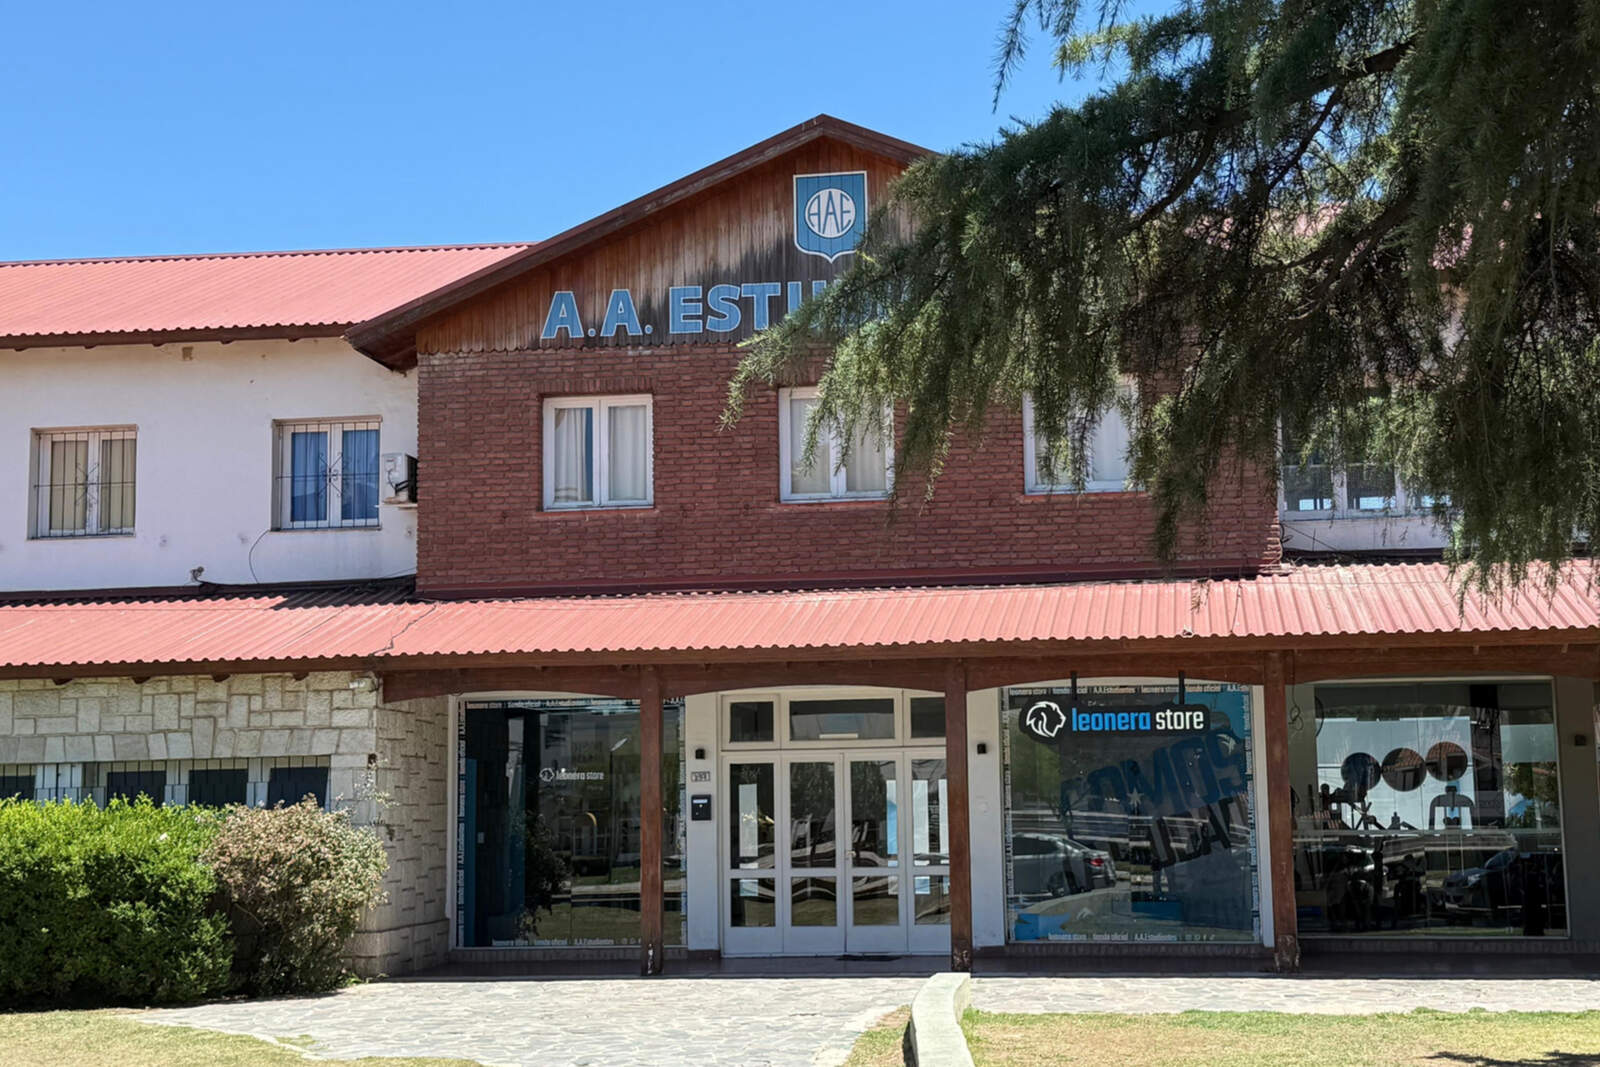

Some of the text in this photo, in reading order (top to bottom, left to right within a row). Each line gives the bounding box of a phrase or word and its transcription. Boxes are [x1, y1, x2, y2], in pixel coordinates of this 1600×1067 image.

[541, 289, 653, 339] A.A.
[1072, 708, 1204, 731] leonera store
